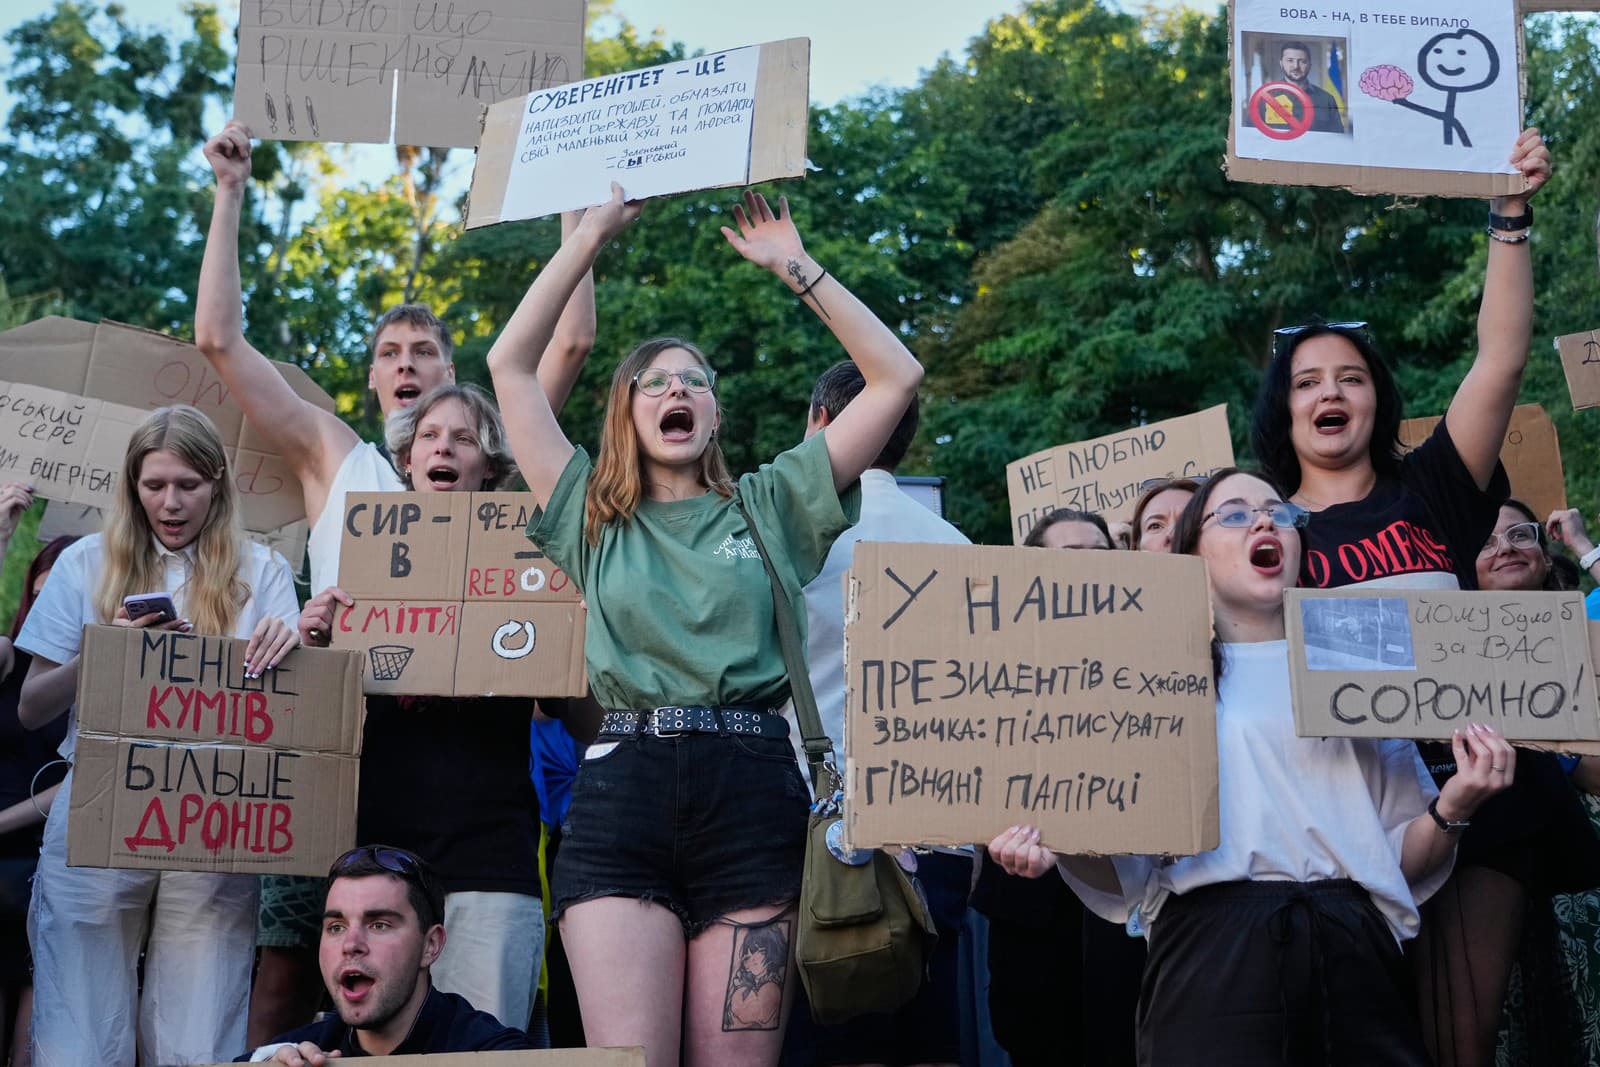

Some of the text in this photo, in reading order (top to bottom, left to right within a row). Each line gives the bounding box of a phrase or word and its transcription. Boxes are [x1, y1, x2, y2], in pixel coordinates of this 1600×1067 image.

[1279, 7, 1318, 20] ВОВА
[1331, 12, 1355, 25] НА,
[1359, 13, 1369, 24] В
[1372, 14, 1407, 26] ТЕБЕ
[1410, 16, 1471, 29] ВИПАЛО
[695, 54, 727, 77] ЦЕ
[669, 81, 747, 105] ОБМАЗАТИ
[669, 107, 689, 122] ТА
[670, 124, 688, 136] НА
[30, 457, 118, 494] ВИГРІБА
[1019, 457, 1053, 495] НЕ
[1068, 430, 1166, 480] ЛЮБЛЮ
[346, 502, 422, 538] СИР
[477, 502, 529, 531] ФЕД
[390, 541, 412, 578] В
[882, 566, 1144, 635] У НАШИХ
[1475, 634, 1555, 664] ВАС
[1329, 664, 1585, 726] СОРОМНО!
[146, 685, 275, 743] КУМІВ
[872, 709, 1185, 748] ЗВИЧКА: ПІДПИСУВАТИ
[125, 743, 301, 801] БІЛЬШЕ
[124, 793, 294, 855] ДРОНІВ
